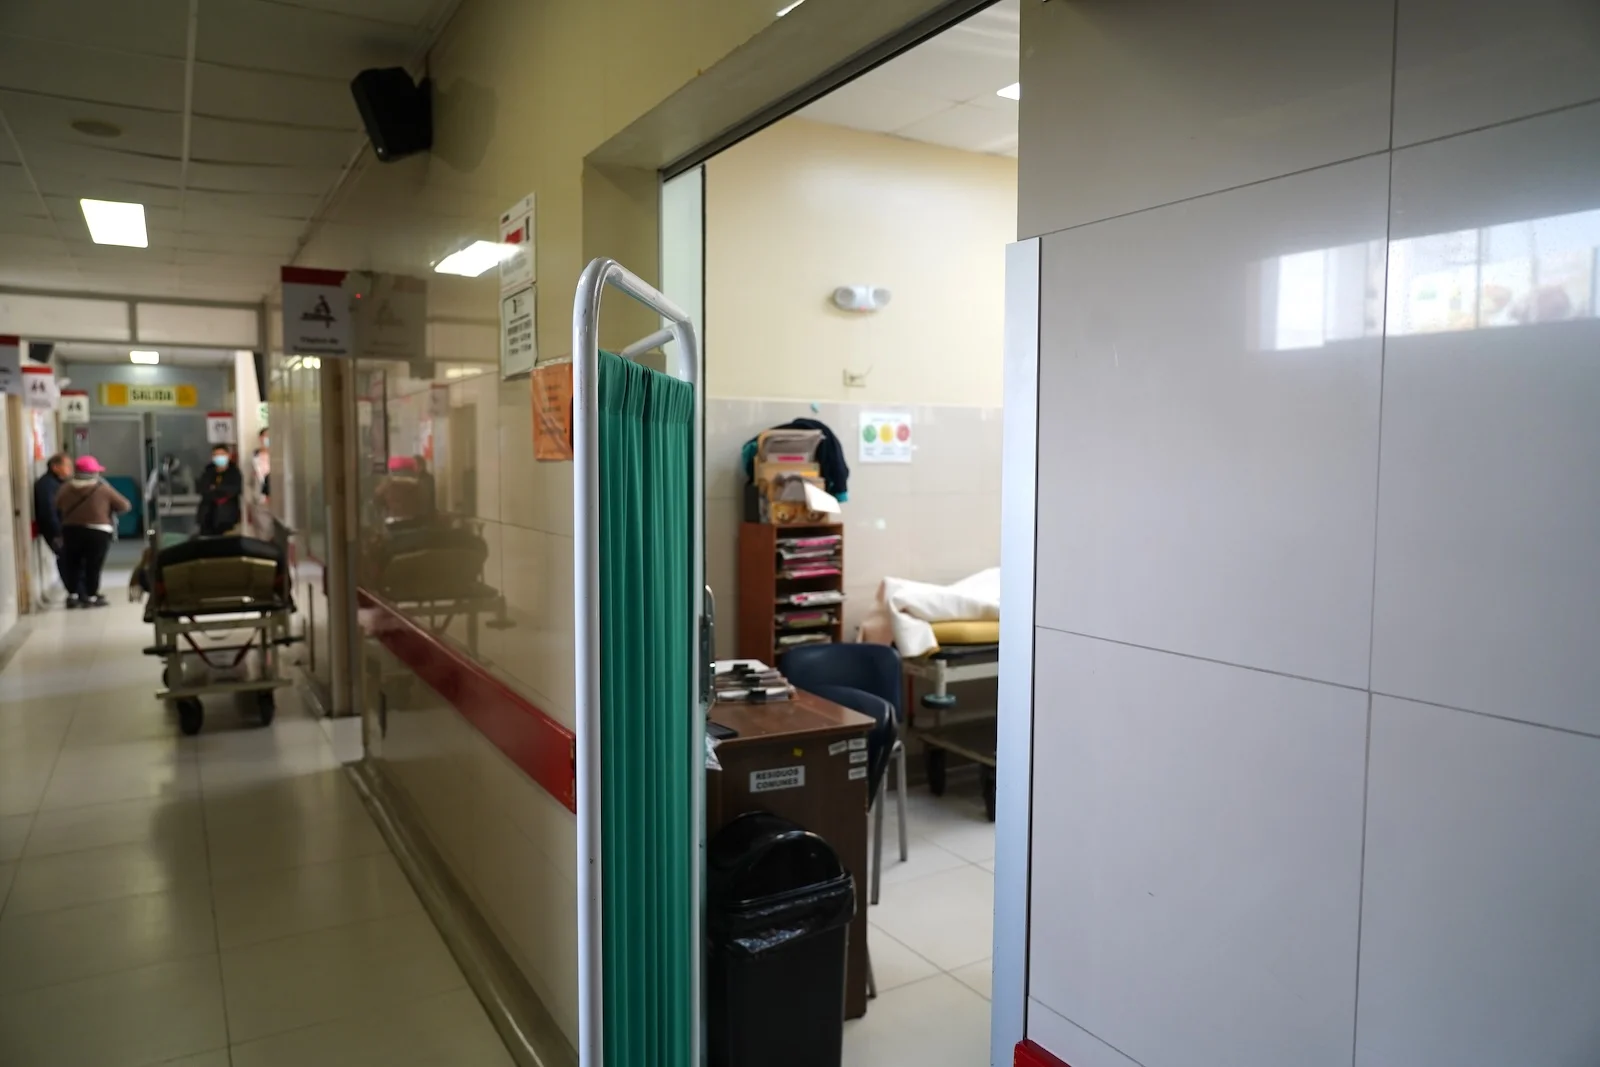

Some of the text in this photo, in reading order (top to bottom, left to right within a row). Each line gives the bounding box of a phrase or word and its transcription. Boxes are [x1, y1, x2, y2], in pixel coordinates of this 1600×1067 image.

[132, 390, 173, 401] SALIDA
[756, 769, 799, 780] RESIDUOS
[756, 778, 798, 789] COMUNES
